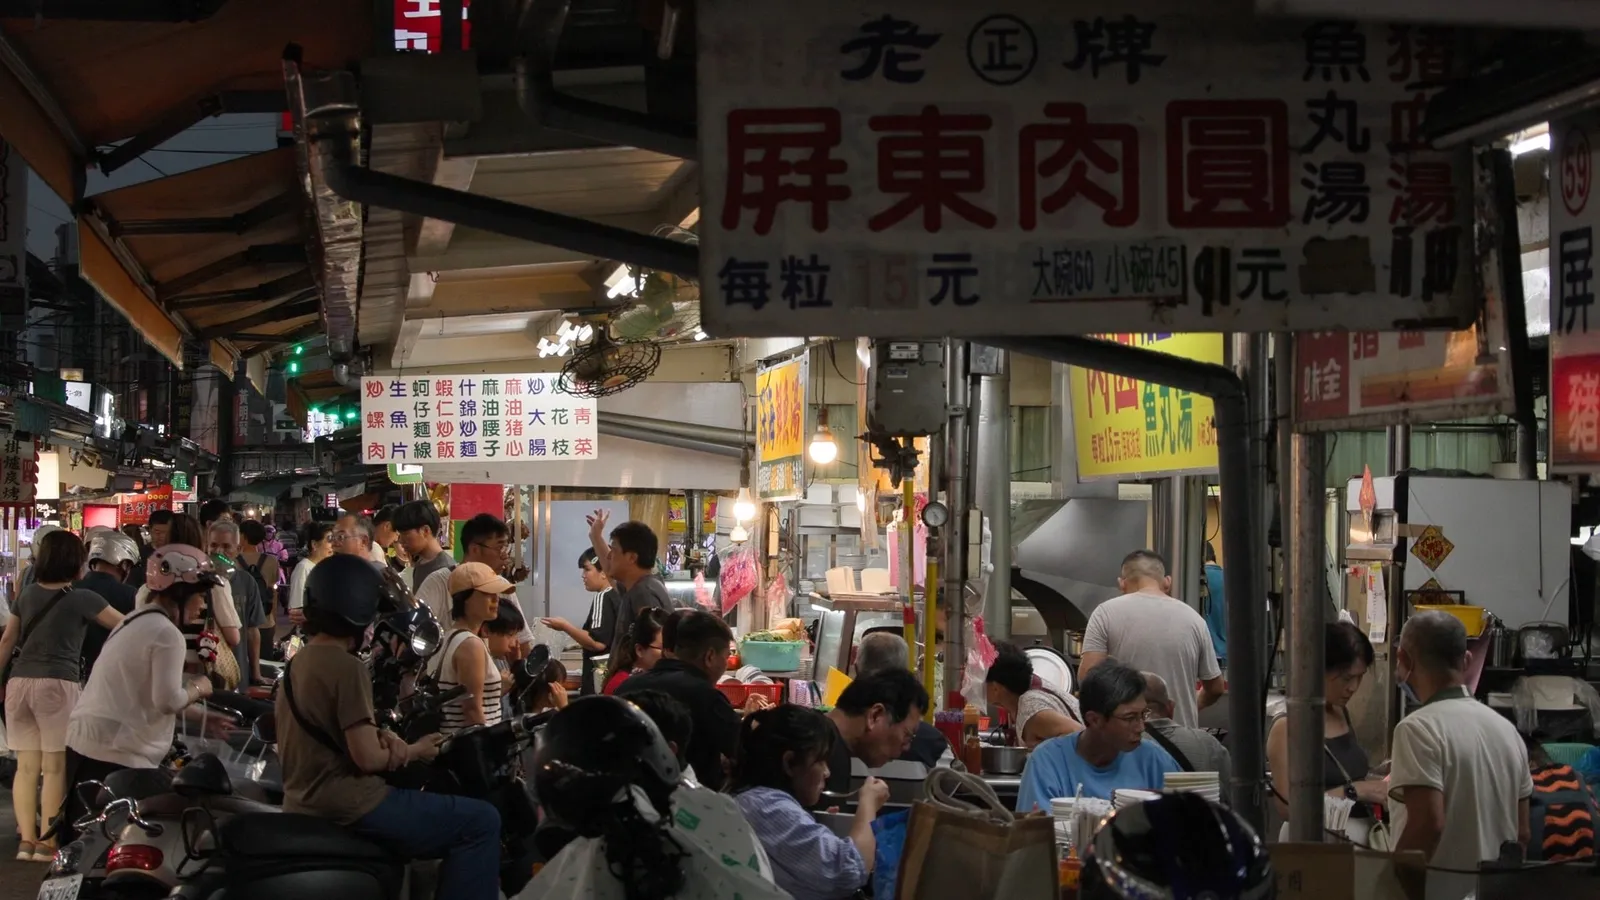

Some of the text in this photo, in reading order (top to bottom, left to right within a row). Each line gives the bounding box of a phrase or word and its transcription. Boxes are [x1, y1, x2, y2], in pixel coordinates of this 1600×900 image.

[1300, 21, 1369, 224] 魚丸湯
[720, 99, 1288, 236] 屏東肉圓
[1032, 246, 1095, 297] 大碗60
[1105, 244, 1180, 295] 小碗45
[1237, 248, 1287, 301] 元
[365, 379, 386, 460] 炒螺肉
[389, 380, 409, 460] 生魚片
[412, 379, 432, 459] 蚵仔麵線
[435, 379, 455, 460] 蝦仁炒飯
[458, 378, 478, 458] 什錦炒麵
[481, 378, 501, 457] 麻油腰子
[527, 377, 547, 456] 炒大腸
